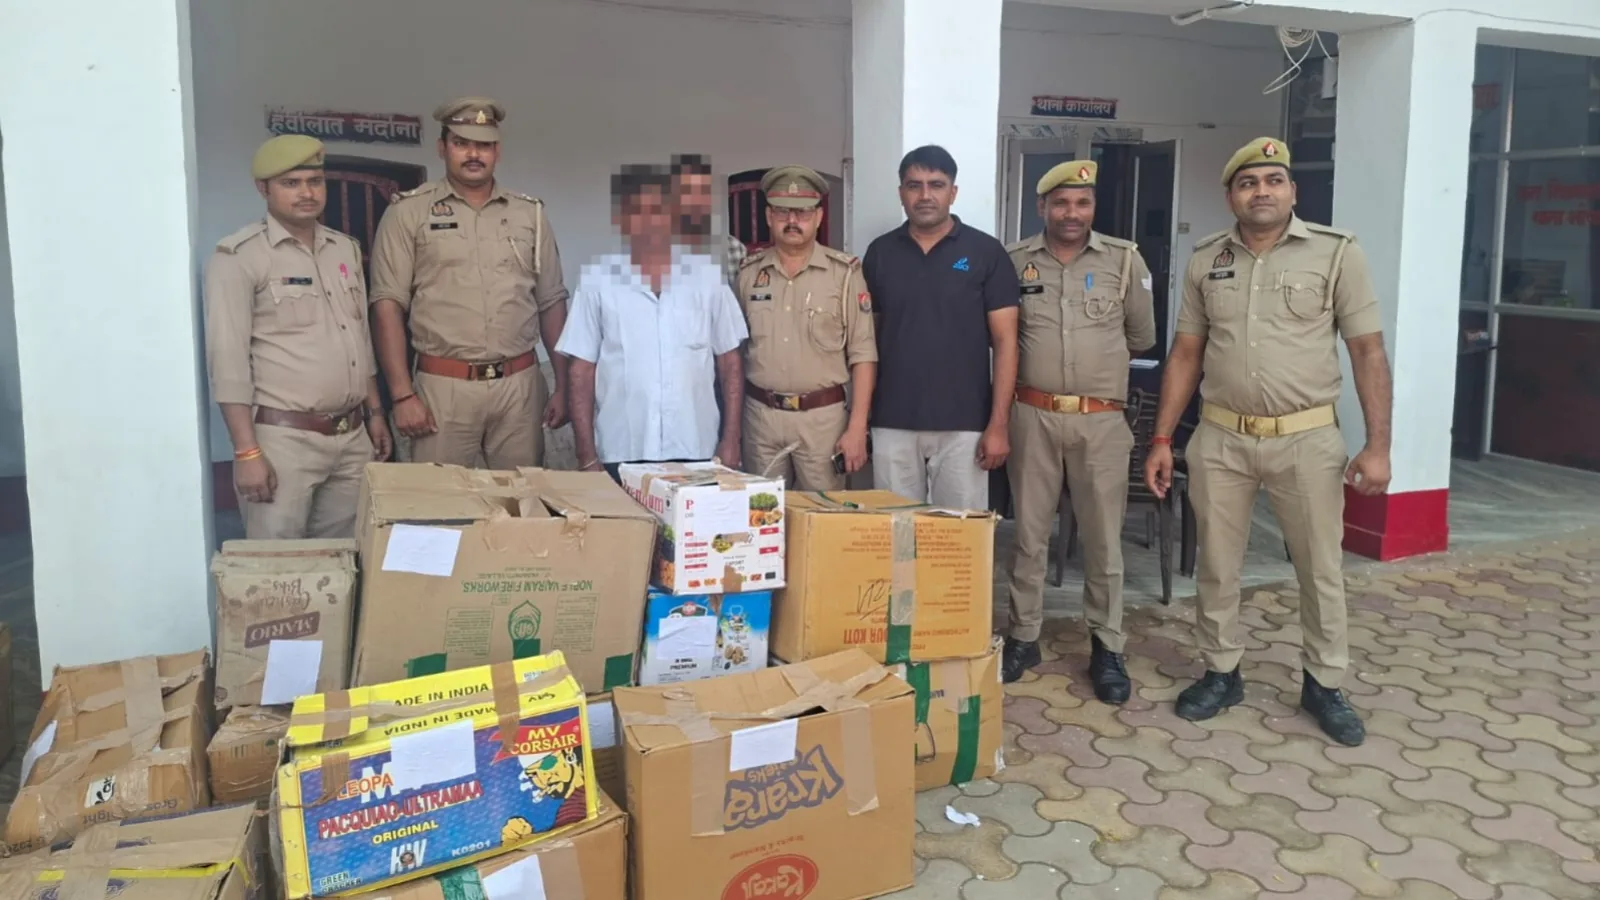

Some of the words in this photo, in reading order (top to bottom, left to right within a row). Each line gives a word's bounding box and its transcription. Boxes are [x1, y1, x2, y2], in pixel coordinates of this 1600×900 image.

[250, 617, 313, 640] MARIO
[428, 691, 443, 701] IN
[449, 683, 489, 698] INDIA
[433, 714, 449, 723] IN
[384, 721, 428, 736] INDIA
[528, 725, 561, 741] MV
[510, 733, 578, 755] CORSAIR
[724, 749, 838, 829] Krara
[372, 820, 439, 845] ORIGINAL
[319, 871, 350, 886] GREEN
